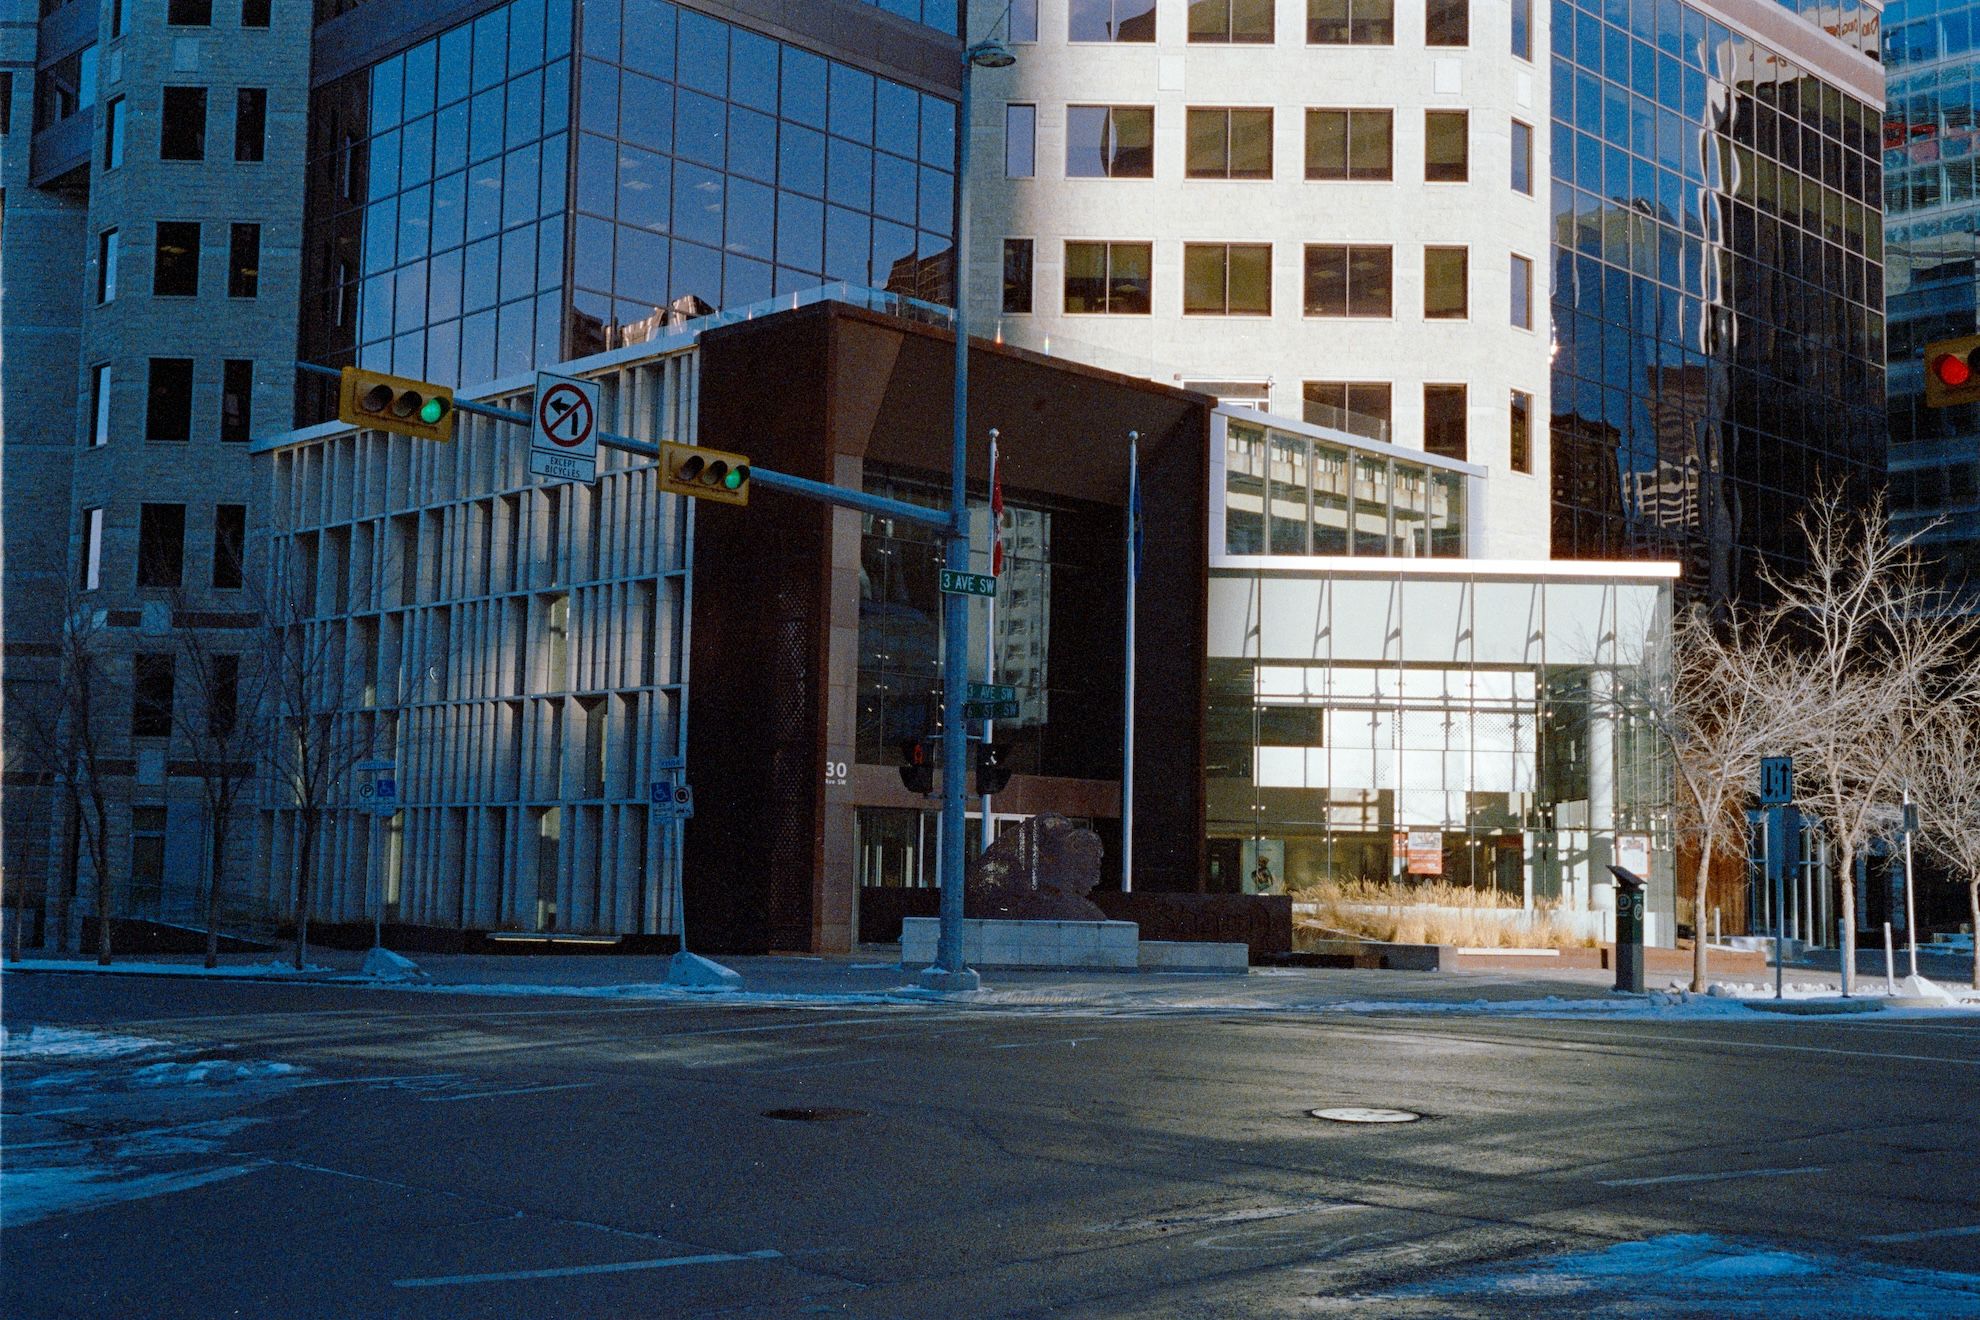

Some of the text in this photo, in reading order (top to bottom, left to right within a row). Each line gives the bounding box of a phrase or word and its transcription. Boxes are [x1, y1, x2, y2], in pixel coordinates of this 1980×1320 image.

[550, 457, 576, 468] EXCEPT
[545, 465, 580, 478] BICYCLES
[943, 573, 994, 594] 3 AVE SW
[968, 684, 1014, 700] 3 AVE SW
